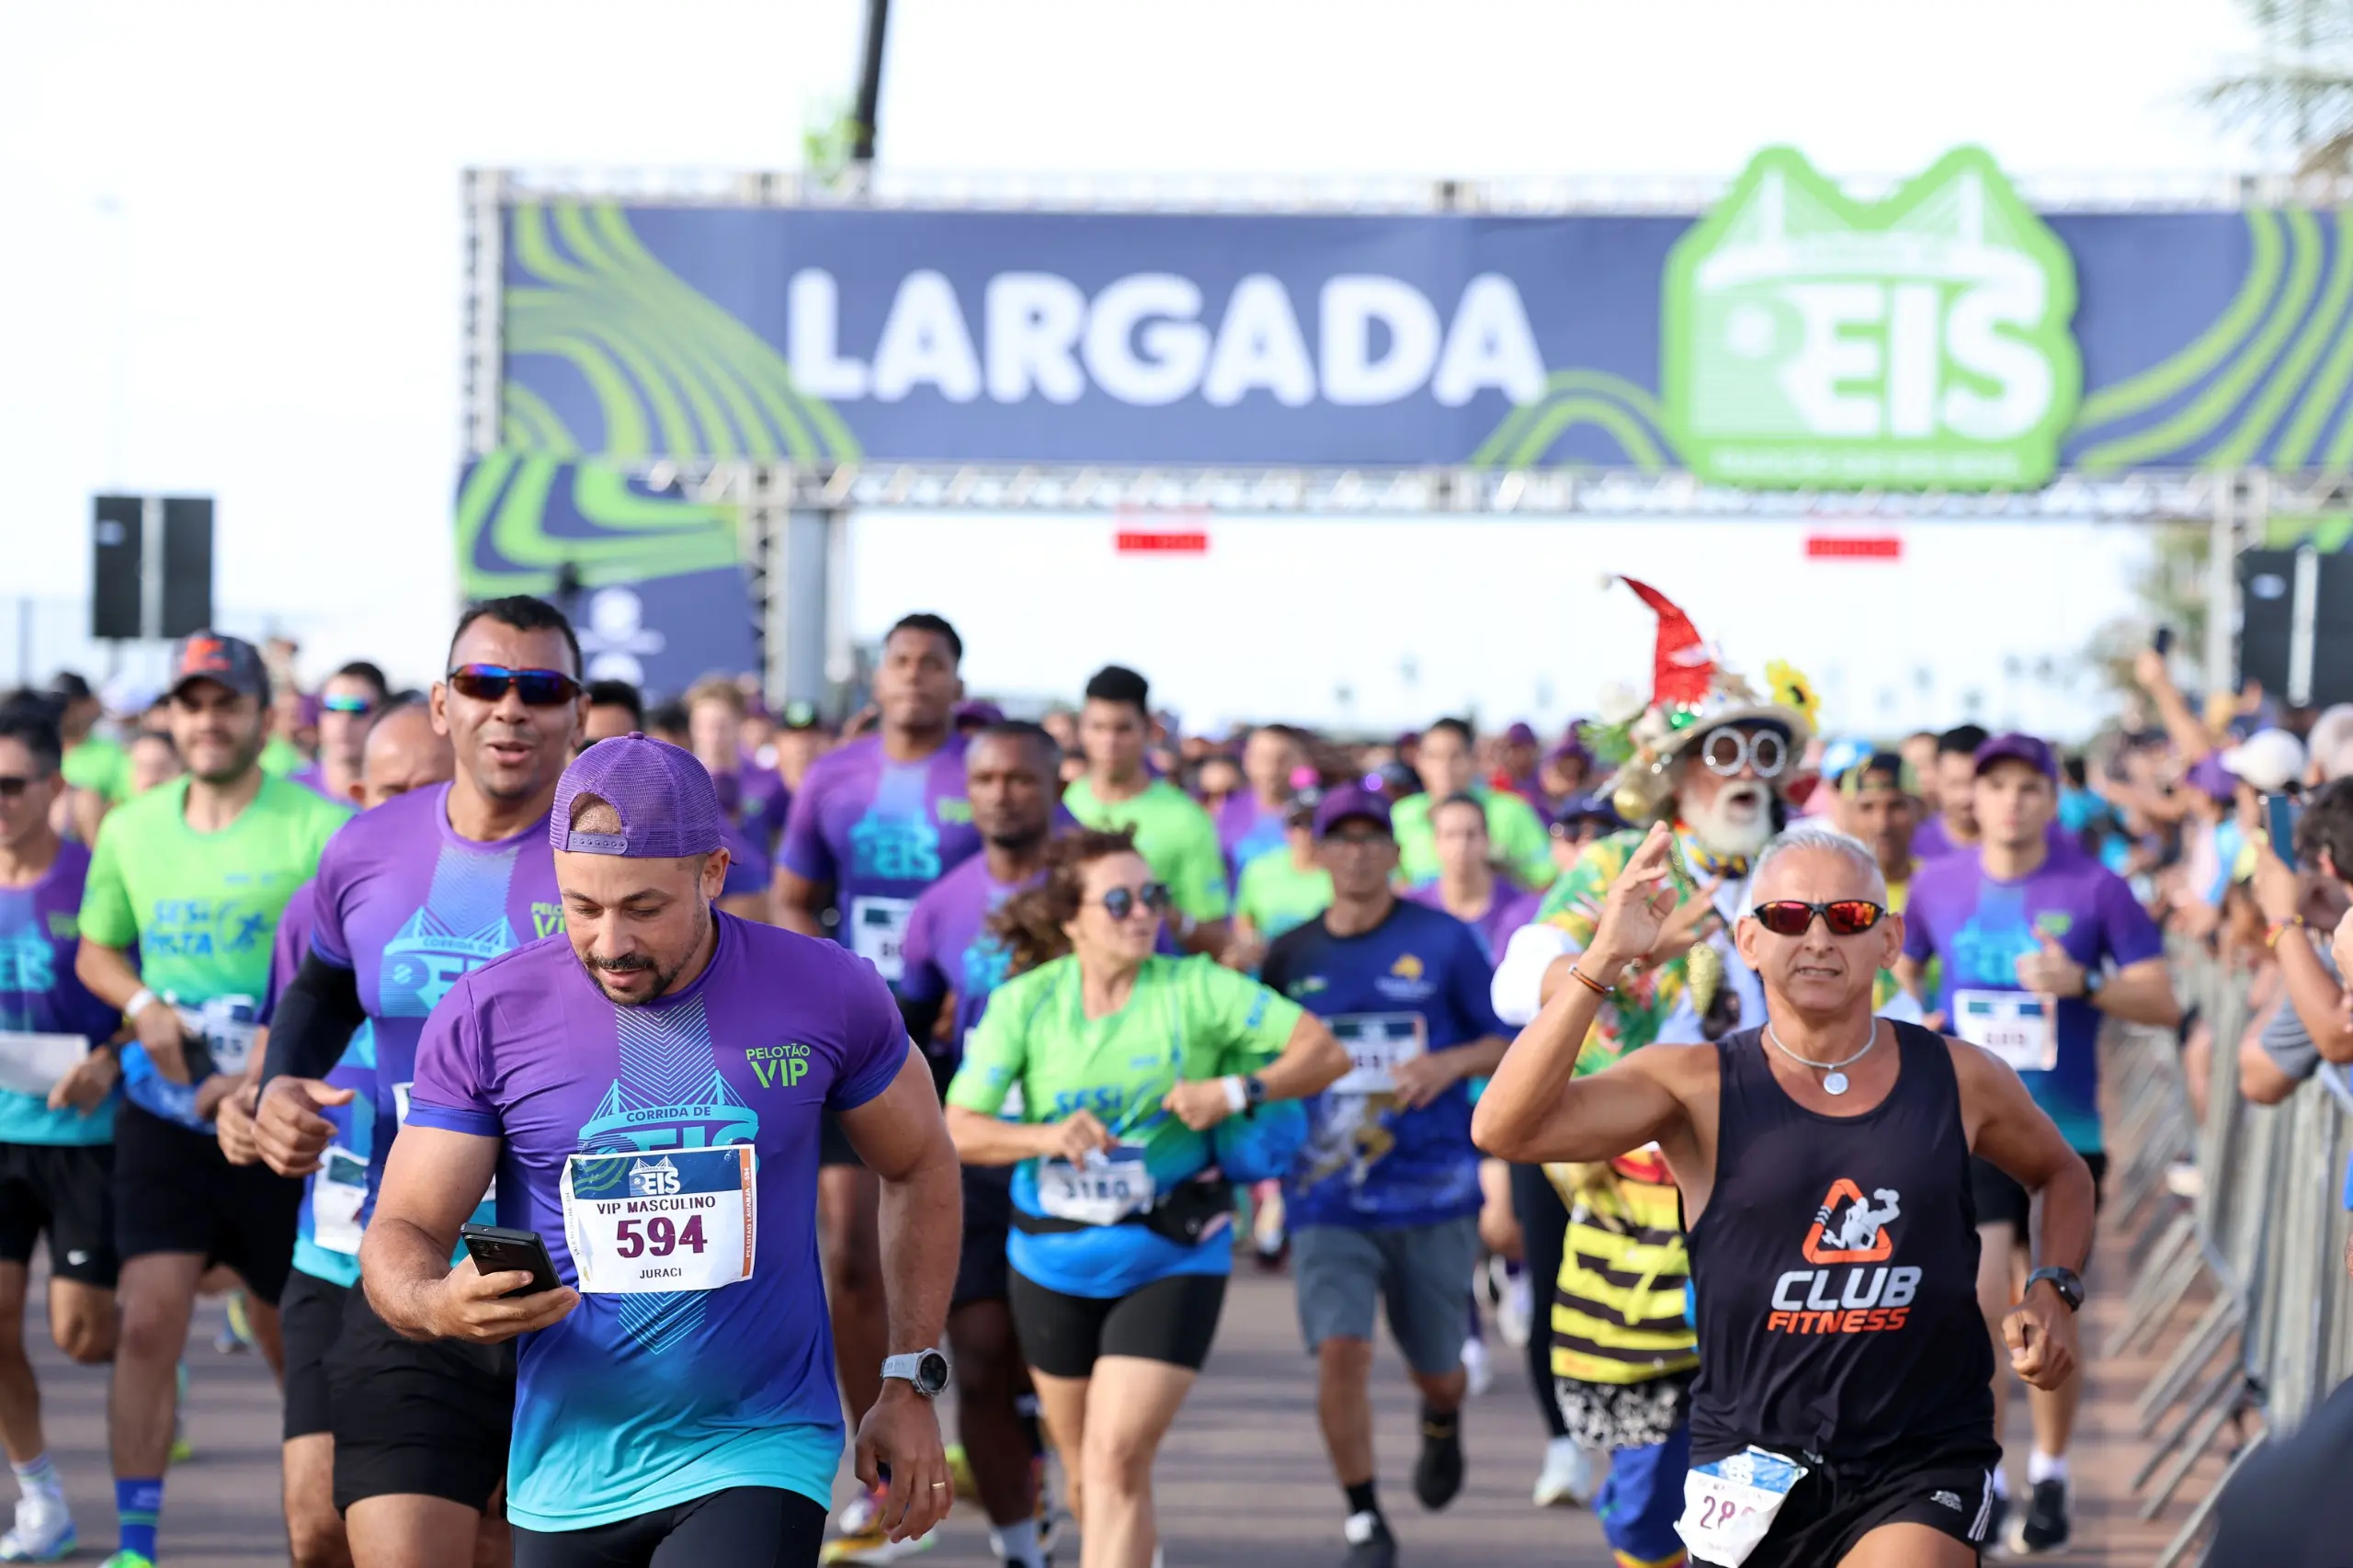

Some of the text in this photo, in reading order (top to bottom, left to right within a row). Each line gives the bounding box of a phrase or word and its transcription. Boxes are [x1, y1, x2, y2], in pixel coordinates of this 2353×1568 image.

[787, 267, 1548, 408] LARGADA
[532, 915, 566, 938] VI
[745, 1043, 811, 1062] PELOTÃO
[750, 1058, 809, 1088] VIP
[626, 1106, 711, 1122] CORRIDA DE
[630, 1171, 681, 1196] REIS
[597, 1196, 716, 1215] VIP MASCULINO
[617, 1214, 708, 1258] 594
[640, 1267, 682, 1279] JURACI
[1771, 1266, 1923, 1311] CLUB
[1768, 1307, 1911, 1334] FITNESS
